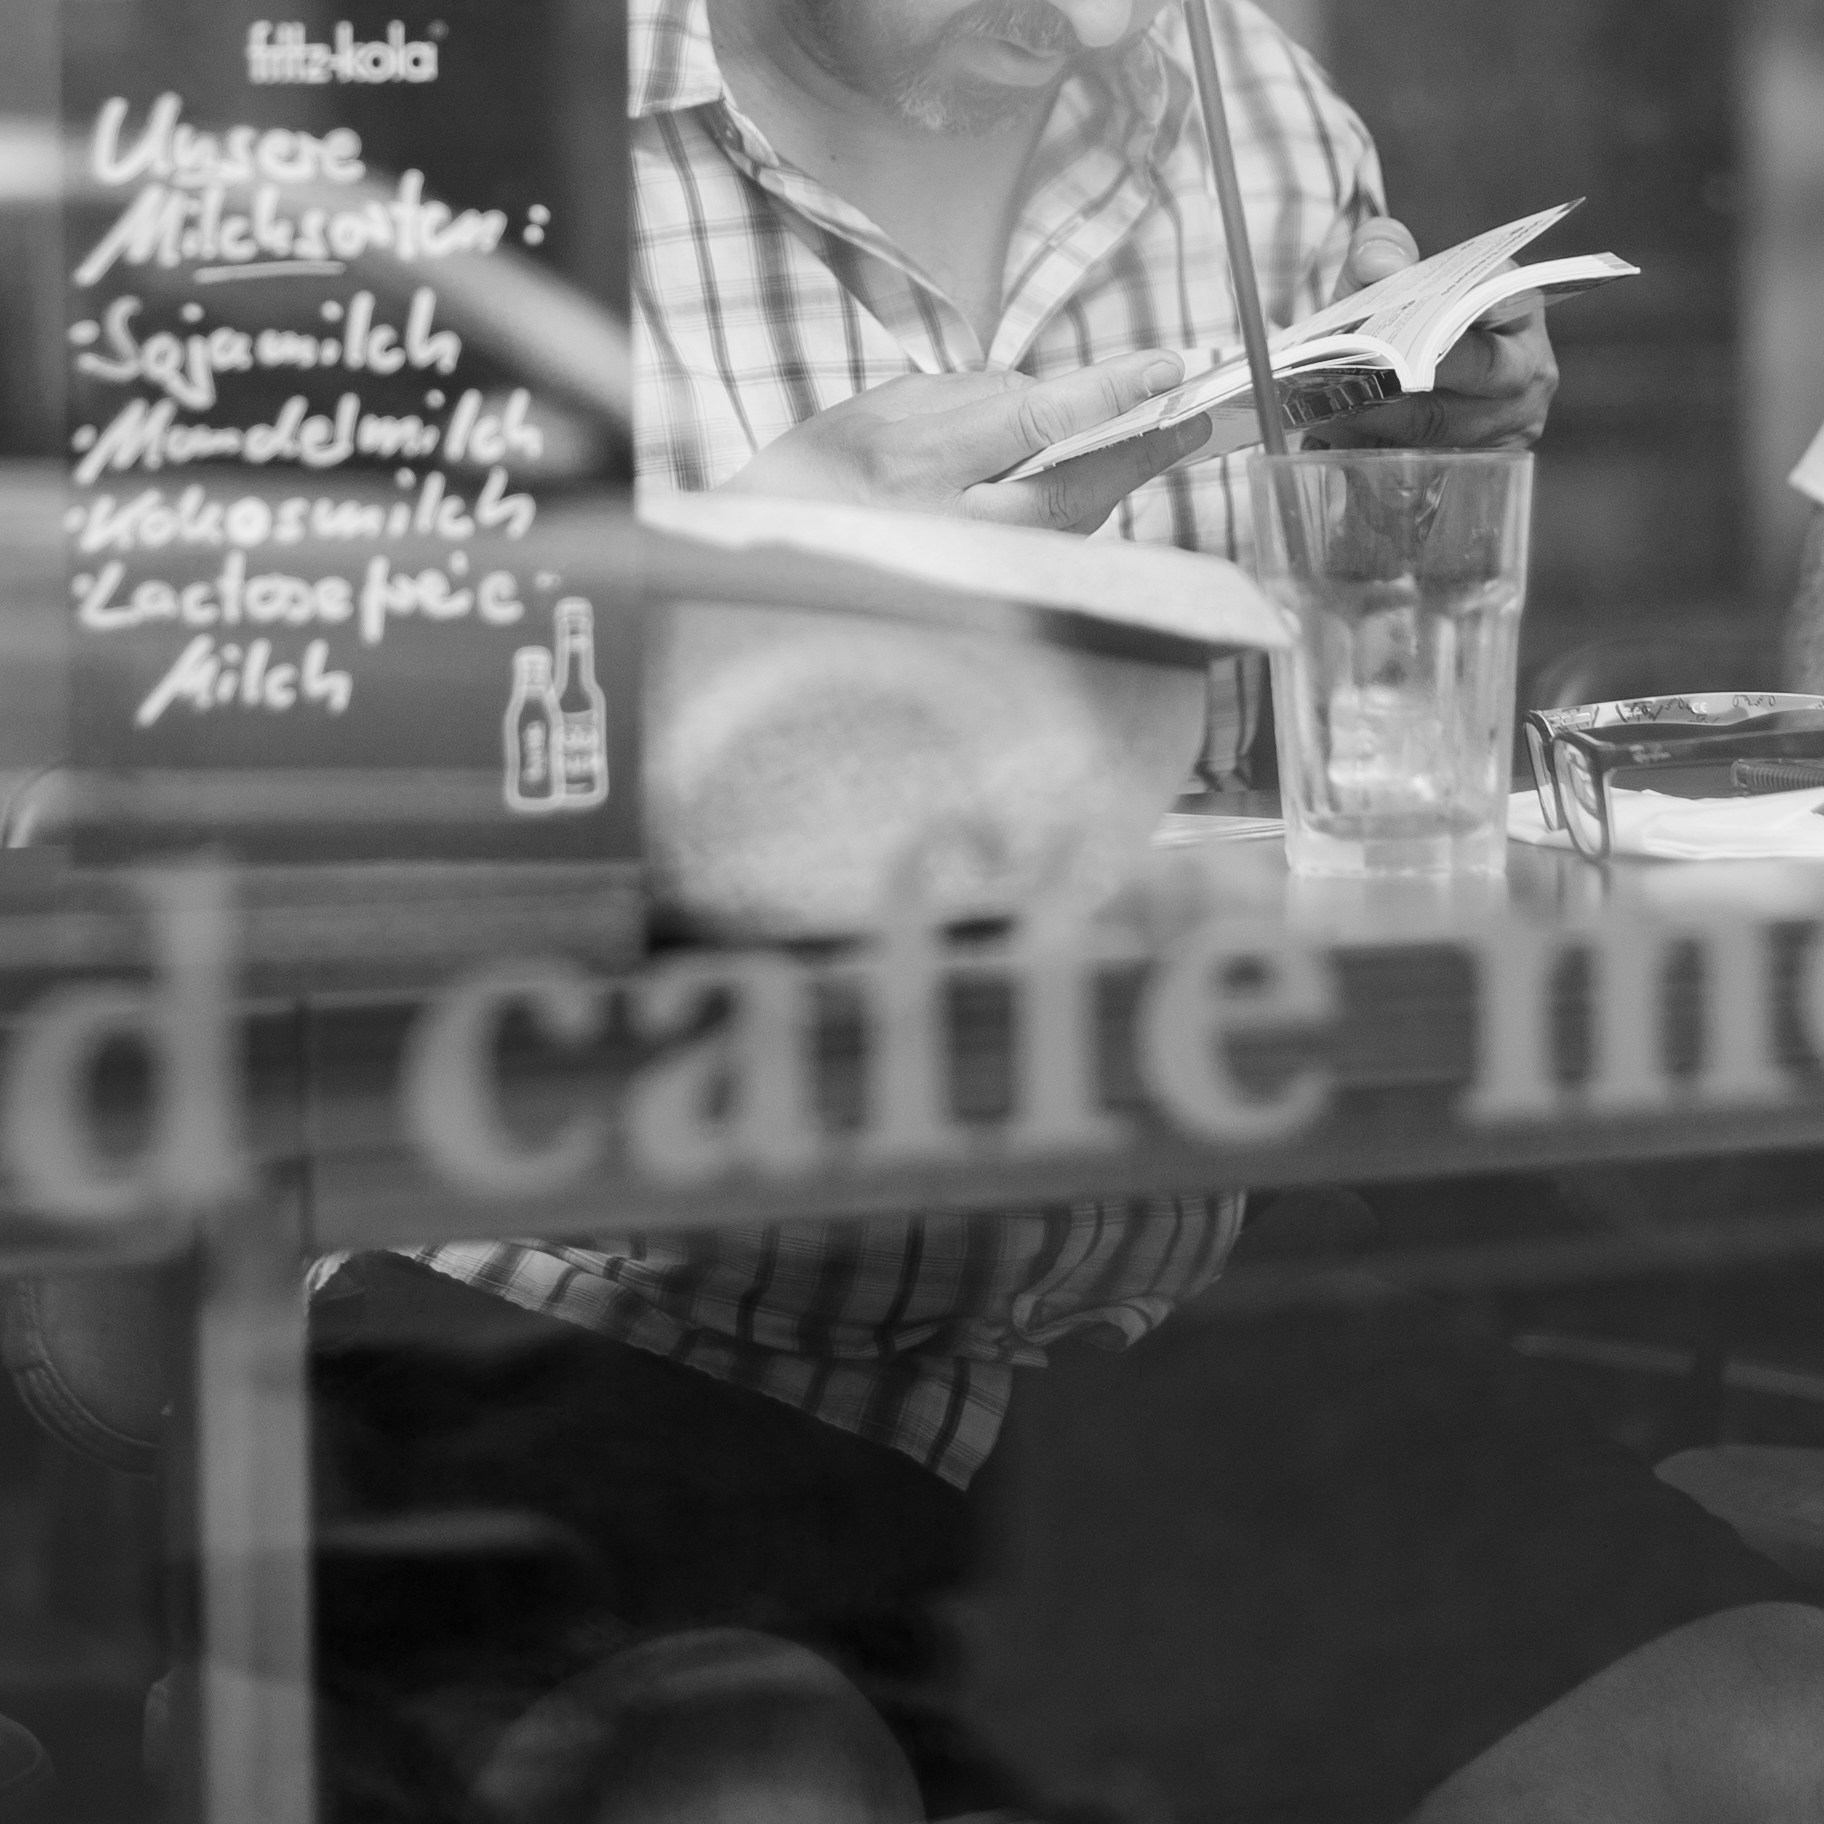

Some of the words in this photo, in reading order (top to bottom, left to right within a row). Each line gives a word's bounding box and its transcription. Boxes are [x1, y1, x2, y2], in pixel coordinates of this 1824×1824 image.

[246, 21, 440, 84] fritz-kola
[89, 91, 366, 184] Unsere
[133, 633, 354, 727] Milch
